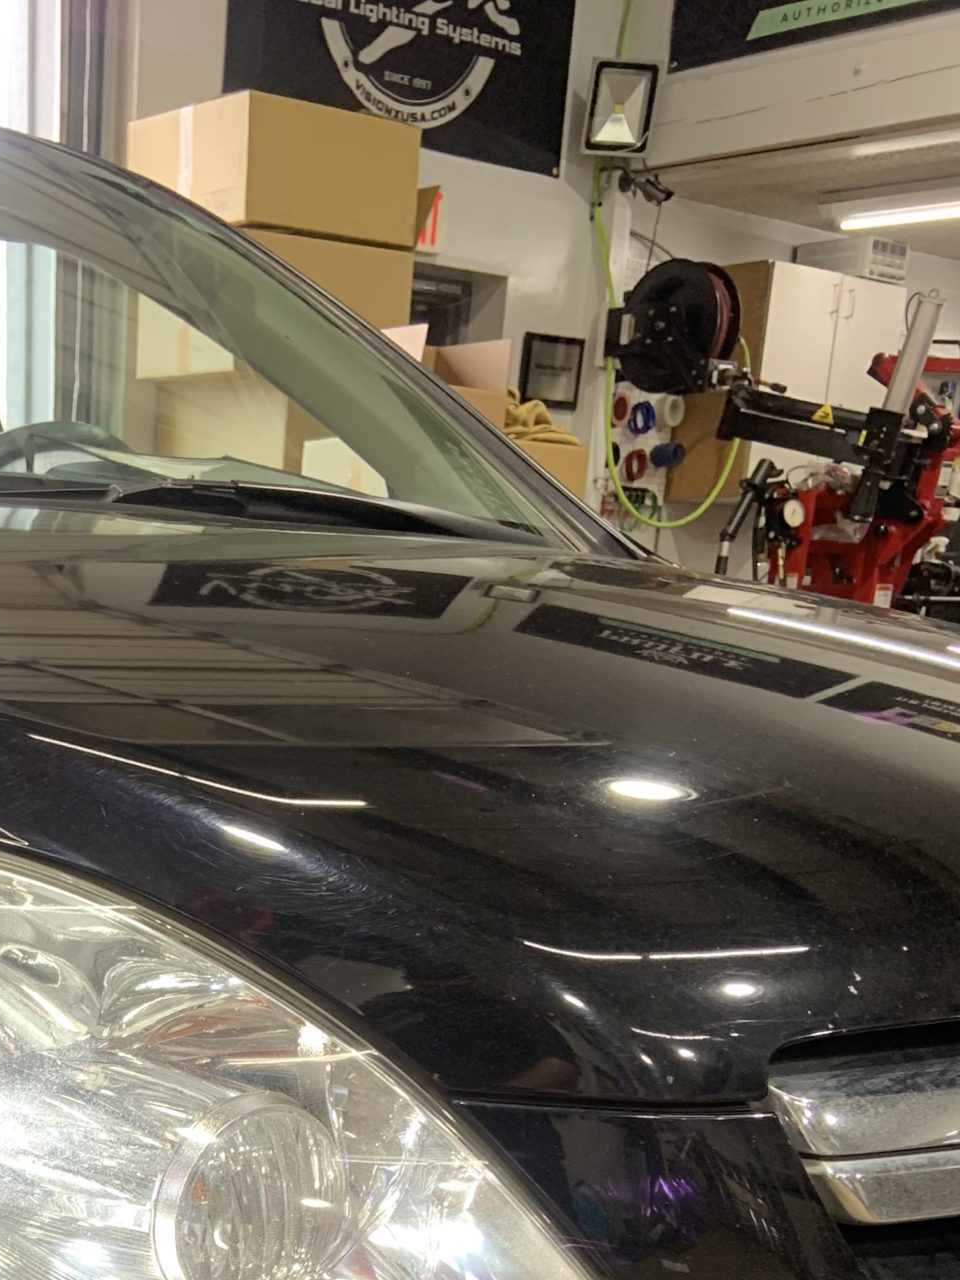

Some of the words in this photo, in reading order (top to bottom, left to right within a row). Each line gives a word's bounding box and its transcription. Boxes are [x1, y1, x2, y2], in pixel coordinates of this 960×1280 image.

[349, 0, 430, 36] Lighting
[435, 17, 522, 56] Systems
[780, 0, 884, 24] AUTHORI
[354, 78, 457, 123] VISIONXUSA.COM
